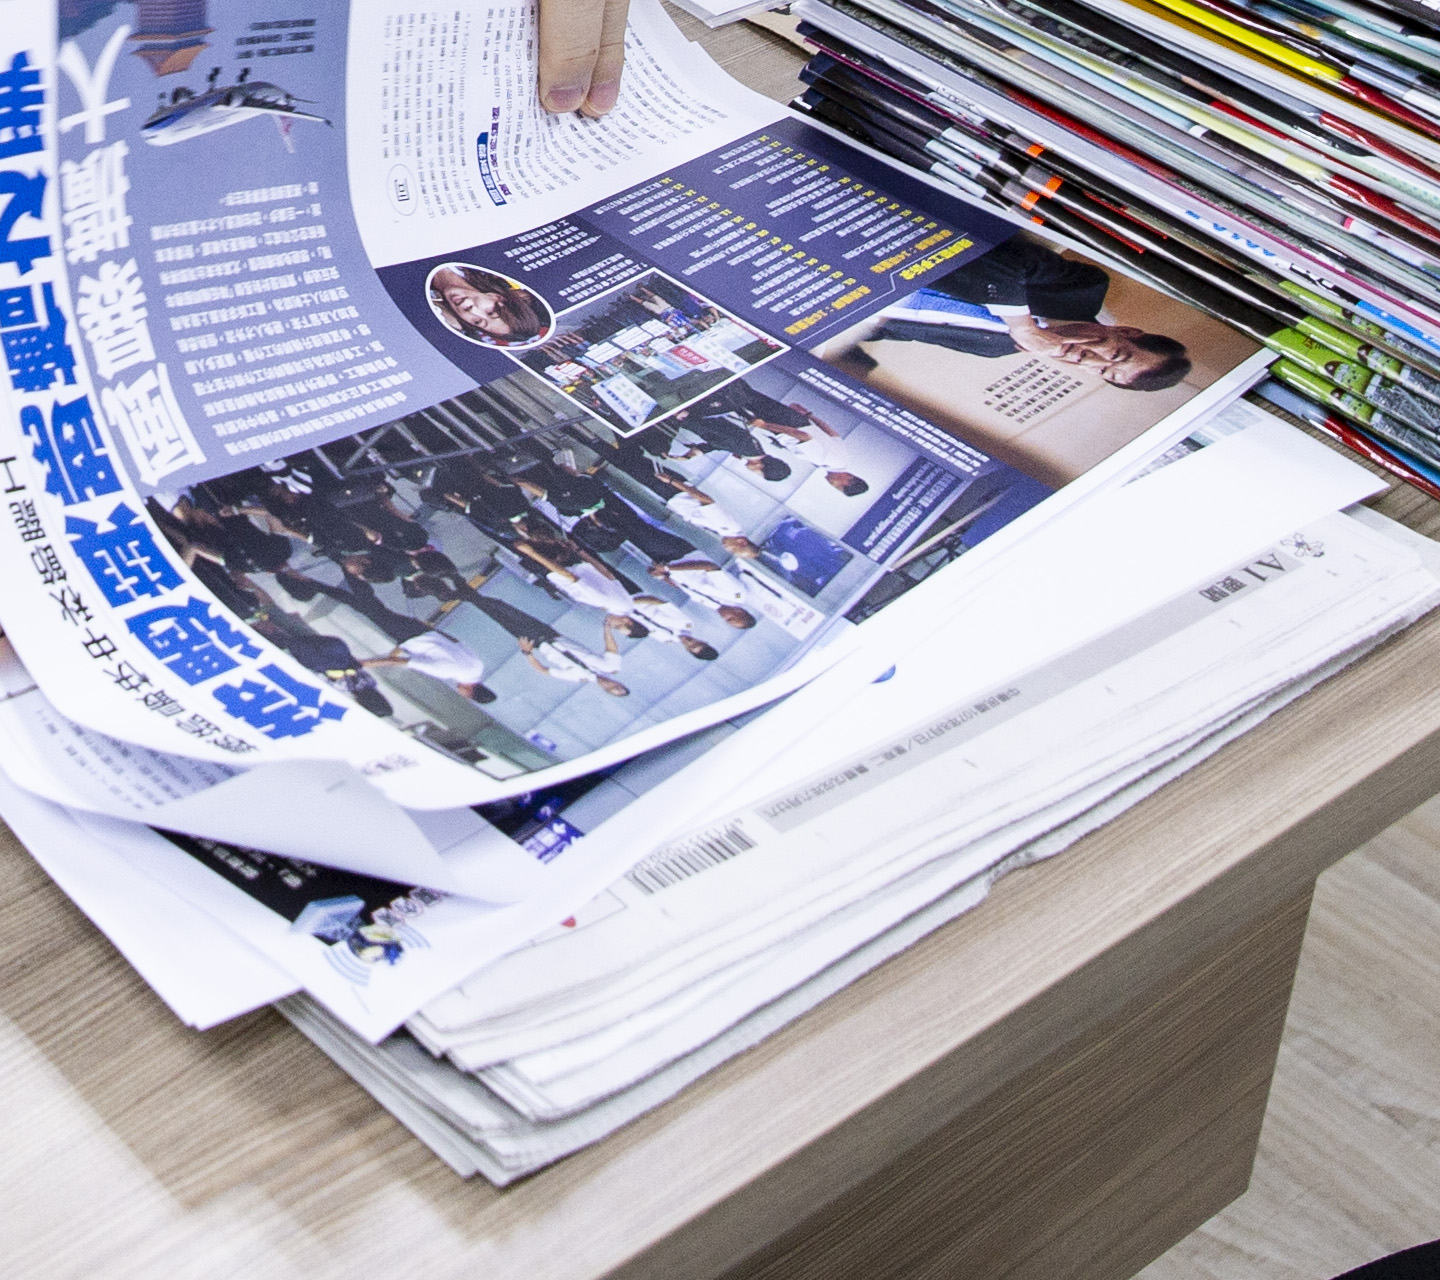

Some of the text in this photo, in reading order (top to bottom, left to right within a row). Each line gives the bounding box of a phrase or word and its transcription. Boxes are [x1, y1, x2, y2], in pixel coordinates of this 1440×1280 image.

[52, 22, 206, 487] 風暴擴大
[1242, 550, 1285, 583] A1
